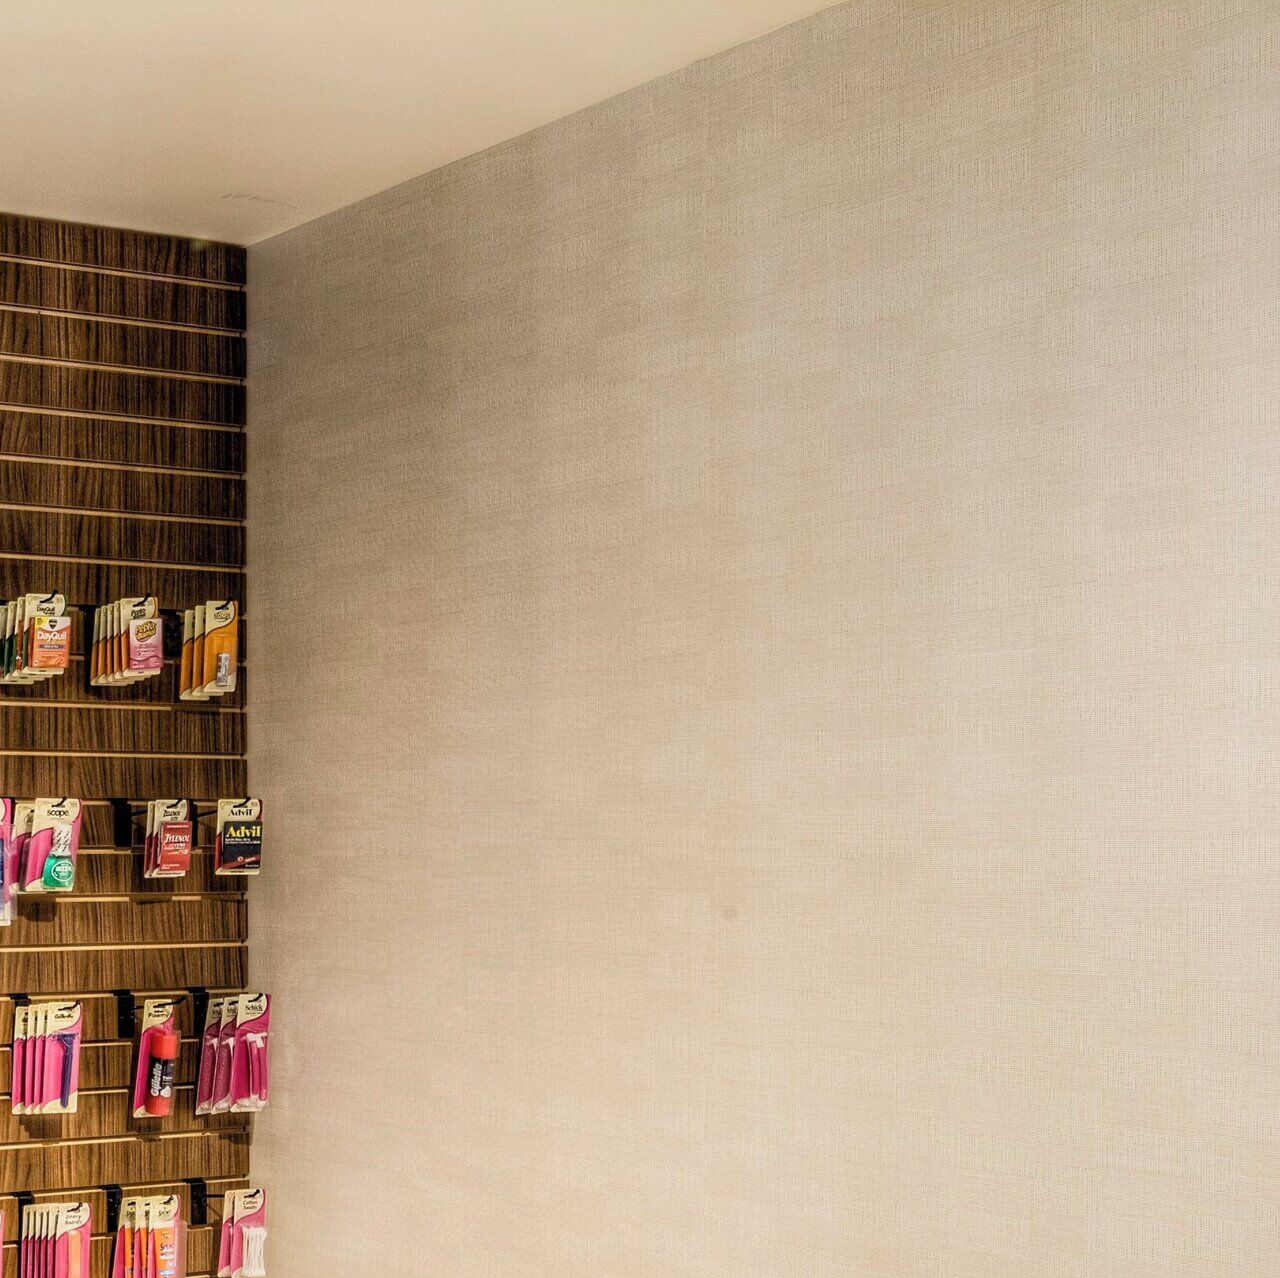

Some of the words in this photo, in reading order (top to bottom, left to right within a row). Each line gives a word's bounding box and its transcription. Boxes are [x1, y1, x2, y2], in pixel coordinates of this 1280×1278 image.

[37, 631, 67, 641] DayQuil
[47, 809, 69, 817] scope
[226, 826, 261, 838] Advil
[151, 1062, 163, 1097] Gillette
